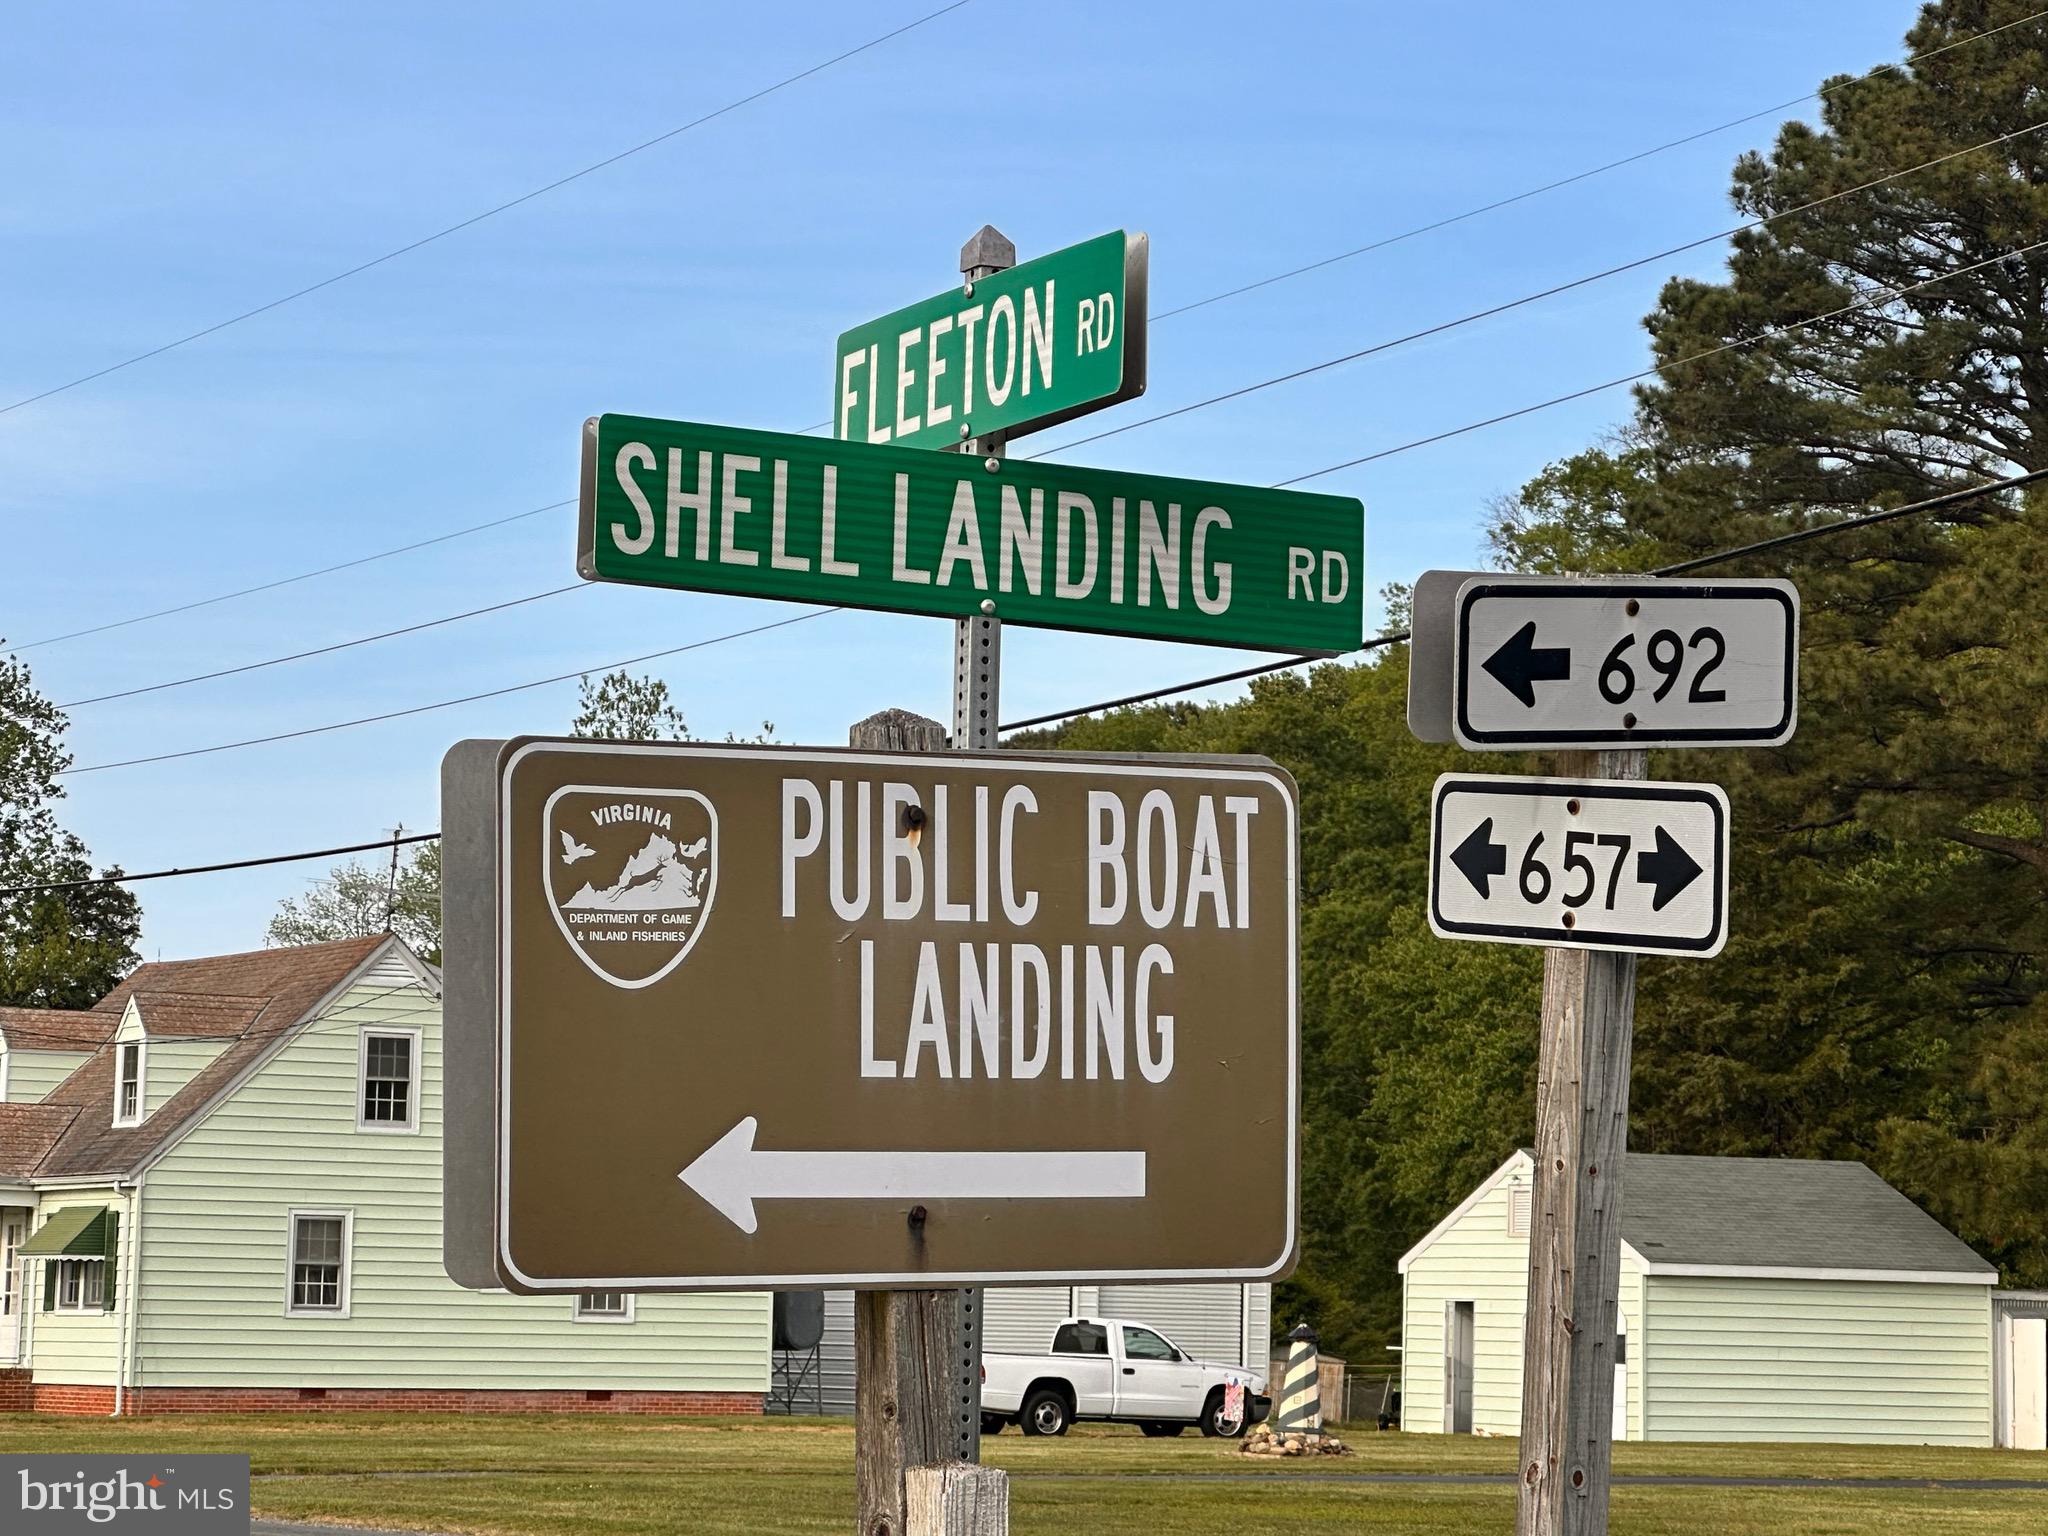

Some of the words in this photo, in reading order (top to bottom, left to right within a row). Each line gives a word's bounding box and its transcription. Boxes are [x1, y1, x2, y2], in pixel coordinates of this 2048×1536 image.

[840, 278, 1056, 444] FLEETON
[1076, 291, 1115, 357] RD
[610, 441, 860, 577] SHELL
[892, 471, 1233, 616] LANDING
[1288, 546, 1350, 604] RD
[1597, 626, 1727, 706] 692
[590, 803, 672, 831] VIRGINIA
[781, 778, 1040, 927] PUBLIC
[1088, 788, 1259, 930] BOAT
[1518, 830, 1632, 911] 657
[569, 912, 638, 925] DEPARTMENT
[642, 913, 658, 925] OF
[661, 913, 693, 925] GAME
[575, 930, 585, 942] &
[589, 930, 628, 942] INLAND
[631, 930, 686, 943] FISHERIES
[860, 939, 1175, 1085] LANDING
